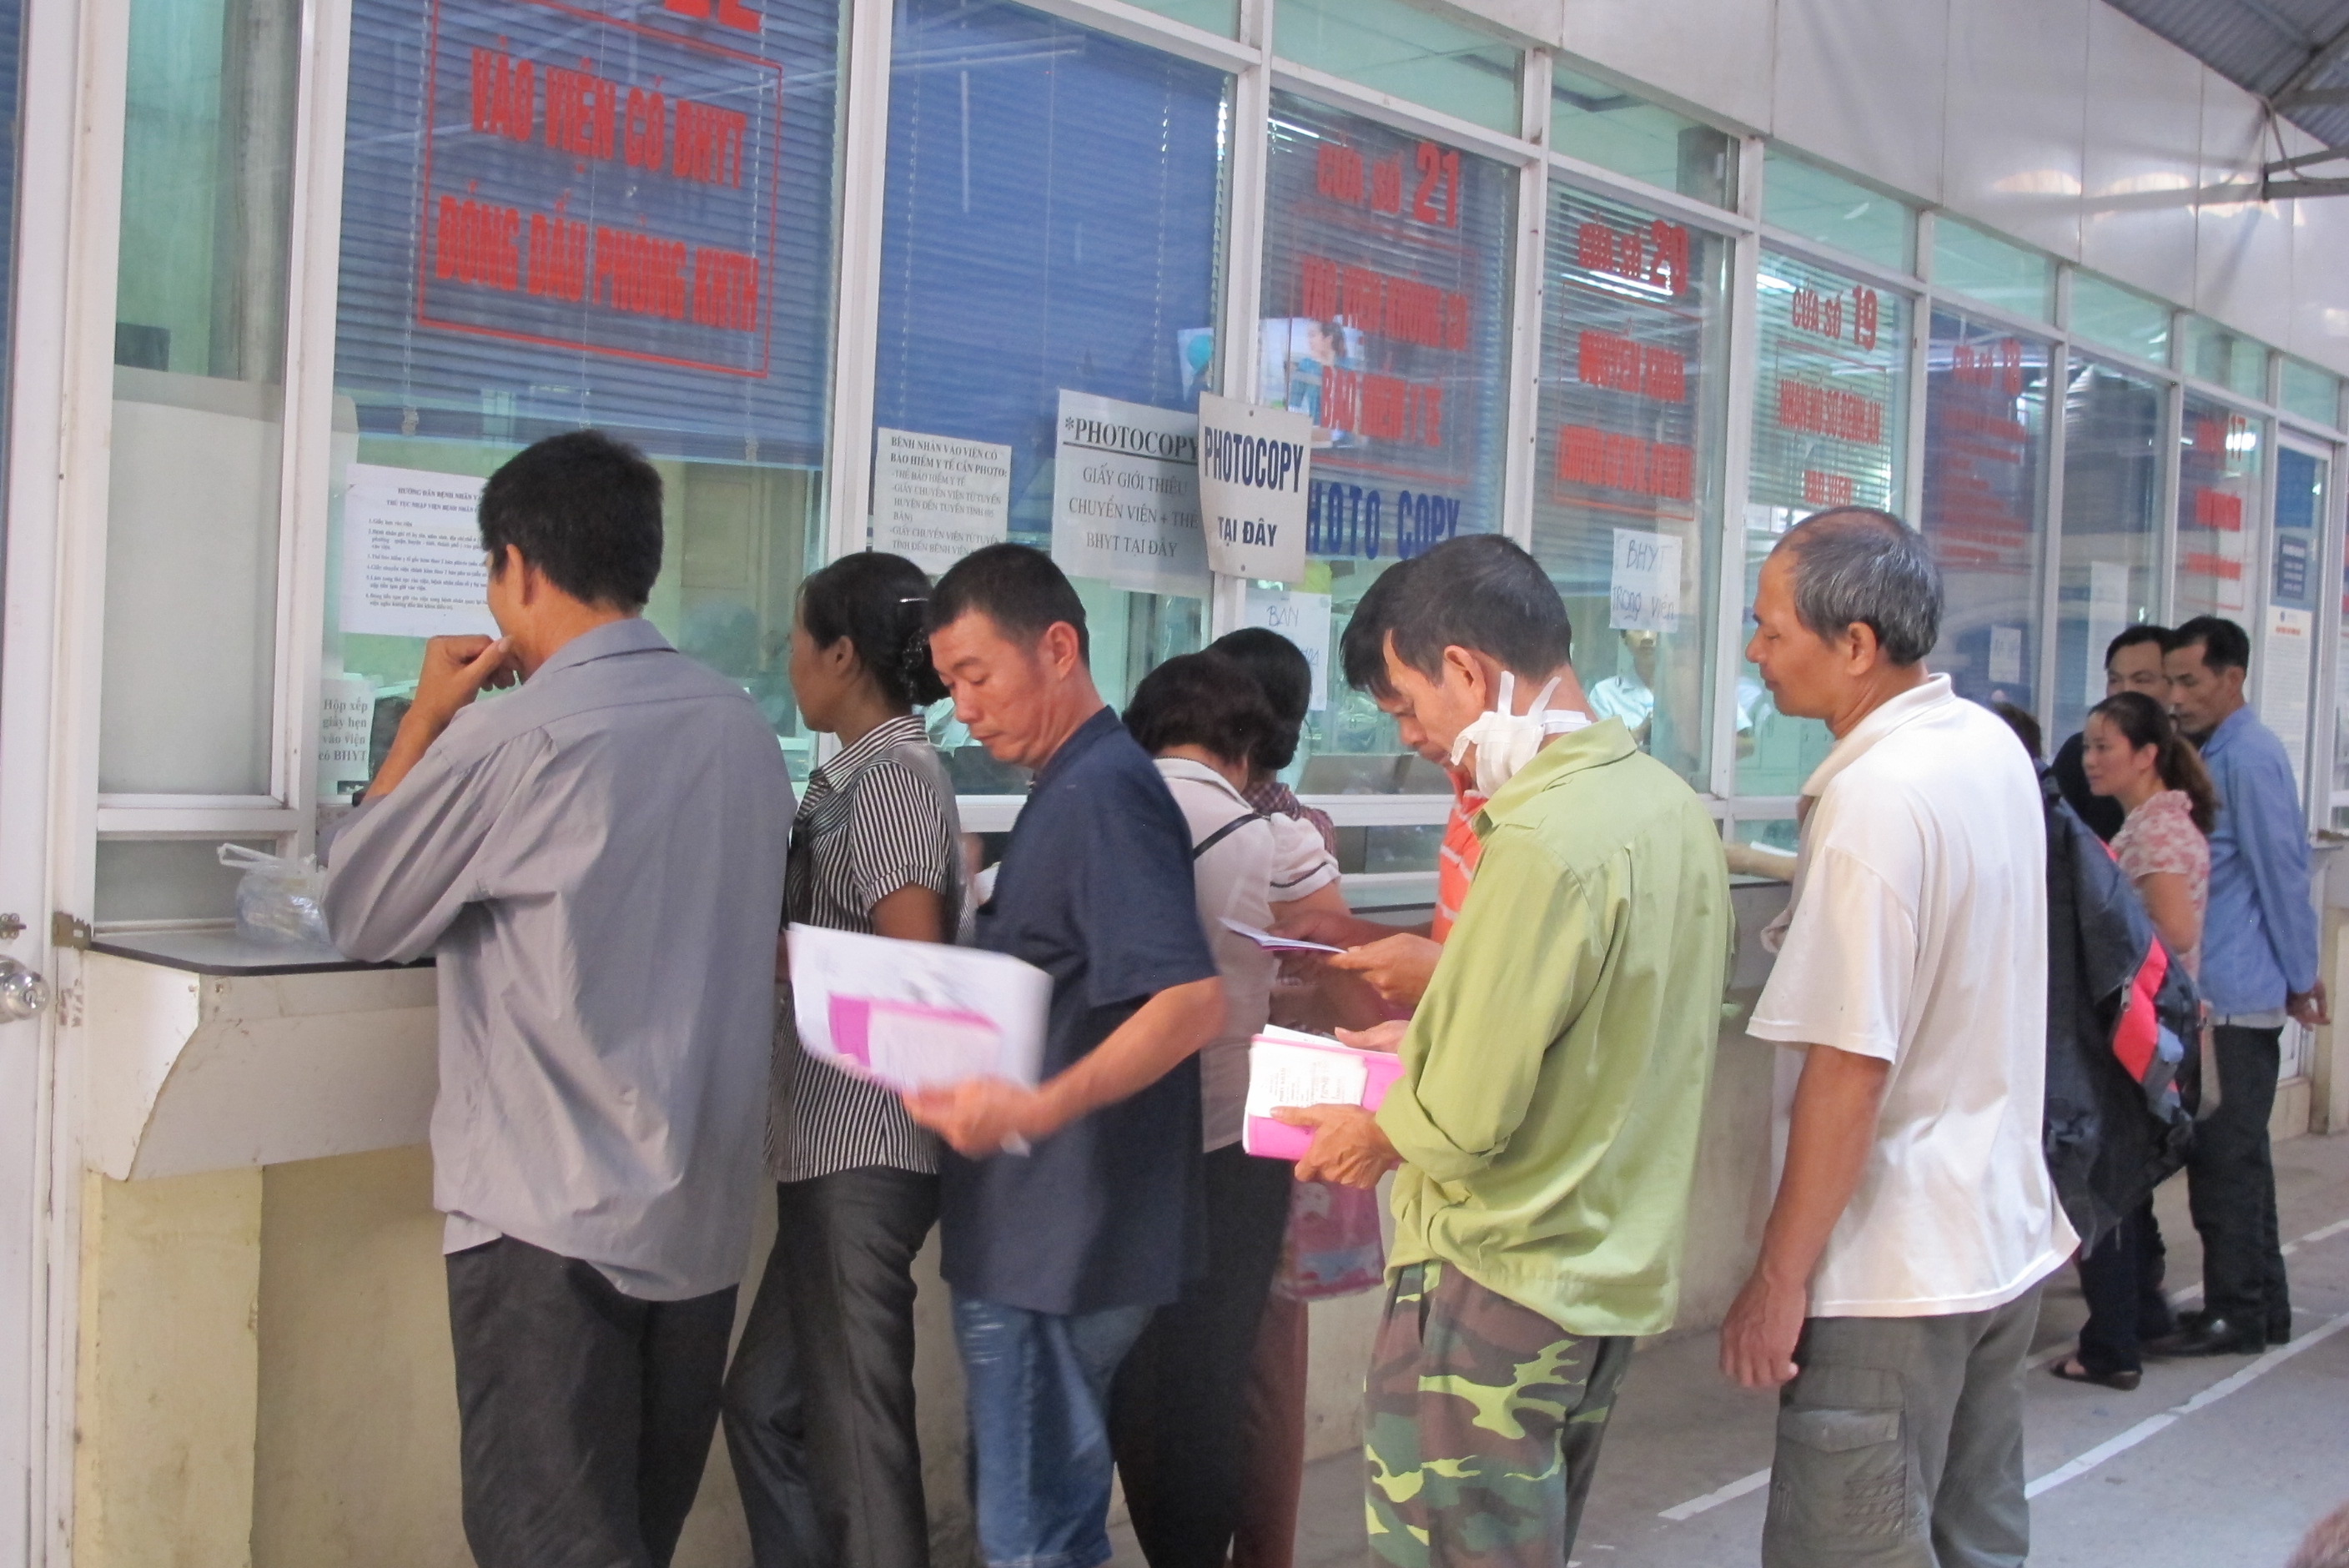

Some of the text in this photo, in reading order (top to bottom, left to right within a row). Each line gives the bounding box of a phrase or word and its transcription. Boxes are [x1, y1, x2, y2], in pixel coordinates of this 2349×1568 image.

[471, 36, 747, 189] VÀO VIỆN CÓ BHYT
[1412, 143, 1461, 229] 21
[527, 188, 587, 303] DẤU
[1853, 285, 1878, 350] 19
[935, 459, 943, 469] Y
[974, 465, 1009, 479] PHOTO:
[1204, 425, 1304, 493] PHOTOCOPY
[1083, 463, 1188, 498] GIẤY GIỚI THIỆU
[1069, 495, 1124, 520] CHUYỂN
[1127, 504, 1157, 527] VIỆN
[1306, 480, 1461, 560] HOTO COPY
[1086, 531, 1178, 558] BHYT TẠI ĐÂY
[1217, 515, 1277, 548] TẠI ĐÂY
[1626, 540, 1673, 573] BHYT
[324, 696, 368, 713] Hộp xếp
[322, 715, 367, 730] giấy hẹn
[345, 730, 365, 747] viện
[334, 750, 366, 761] BHYT
